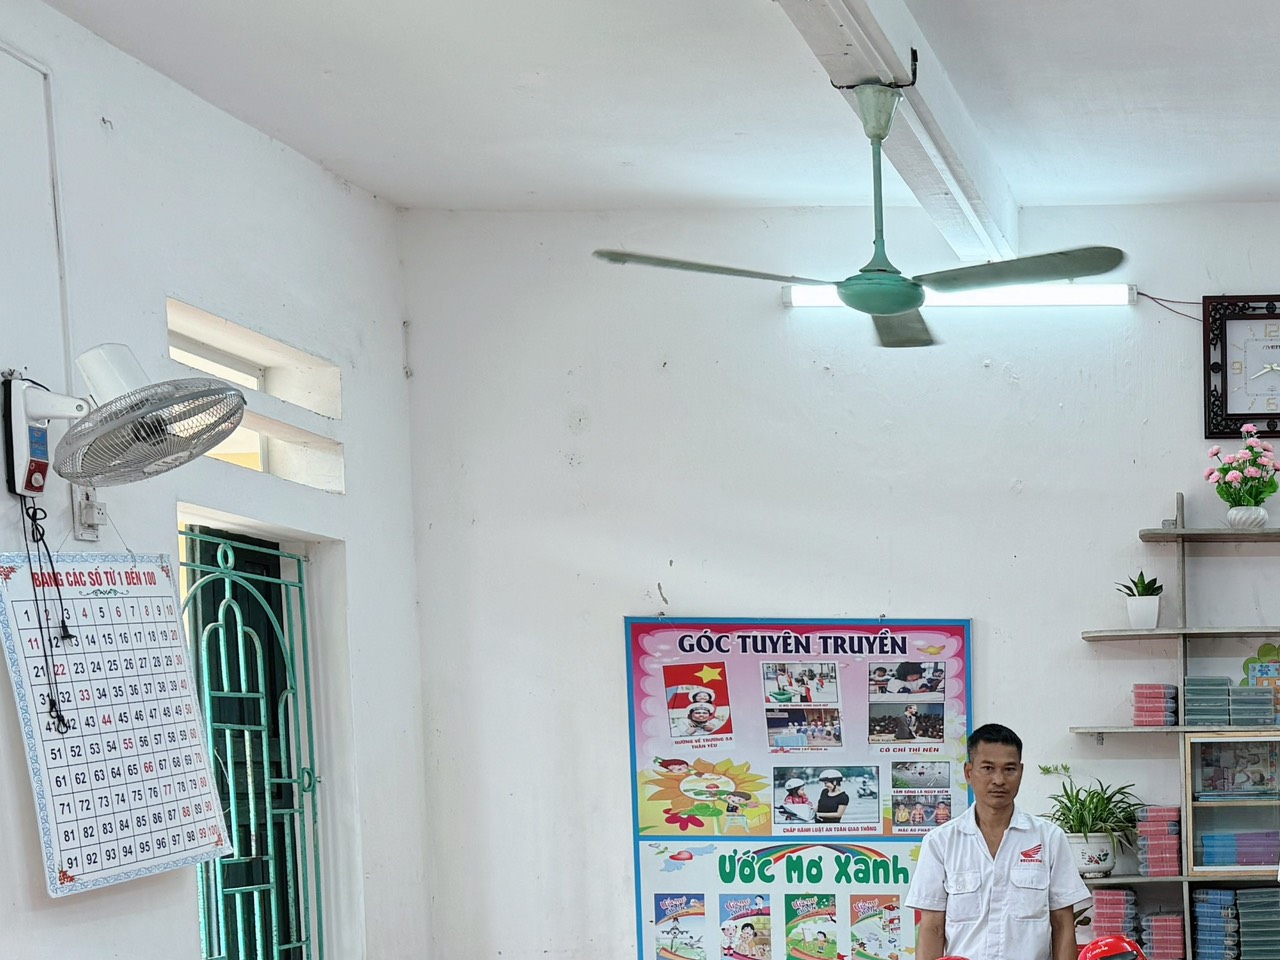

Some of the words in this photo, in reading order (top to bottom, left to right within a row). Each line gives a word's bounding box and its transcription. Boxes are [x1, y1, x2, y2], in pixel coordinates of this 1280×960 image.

[1264, 324, 1280, 337] 12
[65, 568, 86, 586] CÁC
[88, 565, 102, 586] SỐ
[103, 566, 116, 586] TỪ
[117, 571, 124, 586] 1
[125, 564, 142, 586] ĐẾN
[143, 571, 157, 585] 100
[679, 630, 730, 653] GÓC
[738, 632, 811, 654] TUYÊN
[819, 630, 907, 654] TRUYỀN
[140, 736, 148, 747] 56
[154, 734, 161, 745] 57
[168, 732, 176, 742] 58
[90, 743, 100, 754] 53
[107, 740, 116, 752] 54
[123, 738, 133, 750] 55
[51, 748, 62, 760] 51
[70, 745, 82, 757] 52
[144, 762, 153, 772] 66
[159, 759, 166, 770] 67
[172, 757, 180, 768] 68
[94, 769, 105, 781] 63
[111, 767, 121, 778] 64
[128, 764, 138, 776] 65
[56, 775, 67, 787] 61
[75, 772, 86, 784] 62
[148, 787, 158, 798] 76
[163, 784, 171, 795] 77
[177, 782, 186, 792] 78
[115, 793, 125, 804] 74
[132, 790, 142, 801] 75
[60, 802, 71, 814] 71
[79, 799, 91, 811] 72
[98, 796, 109, 808] 73
[153, 812, 162, 824] 86
[168, 809, 176, 820] 87
[182, 807, 191, 817] 88
[119, 819, 129, 831] 84
[136, 816, 146, 827] 85
[83, 826, 94, 838] 82
[102, 822, 113, 834] 83
[64, 830, 75, 842] 81
[172, 834, 180, 846] 97
[187, 831, 195, 842] 98
[140, 841, 150, 853] 95
[156, 838, 166, 849] 96
[106, 848, 116, 861] 93
[122, 845, 132, 857] 94
[67, 856, 78, 869] 91
[86, 852, 98, 865] 92
[718, 849, 776, 884] Ước
[786, 855, 824, 884] Mơ
[834, 855, 910, 884] Xanh
